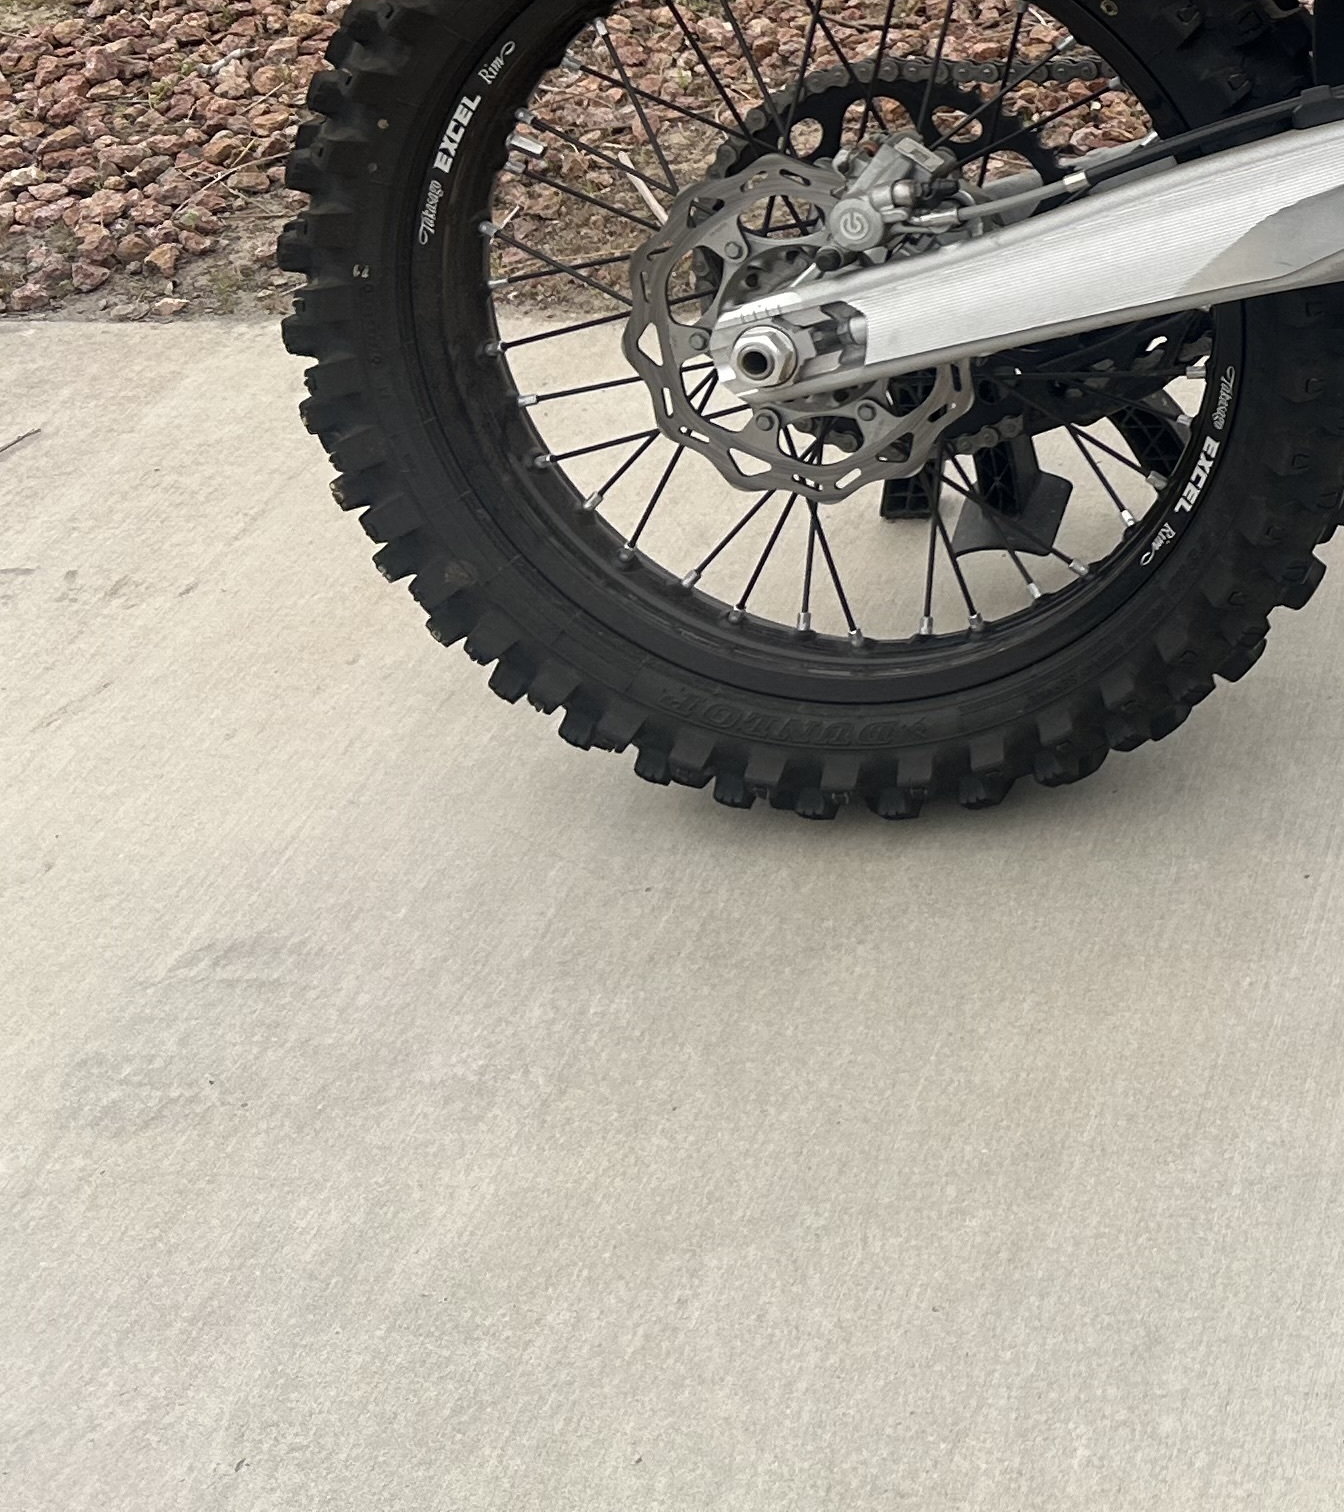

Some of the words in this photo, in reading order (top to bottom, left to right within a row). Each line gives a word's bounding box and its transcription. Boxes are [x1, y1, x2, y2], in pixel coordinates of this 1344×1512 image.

[418, 179, 445, 246] Takasago
[433, 94, 482, 174] EXCEL
[477, 40, 516, 86] Rim
[1173, 435, 1221, 513] EXCEL
[1139, 522, 1177, 566] Rim
